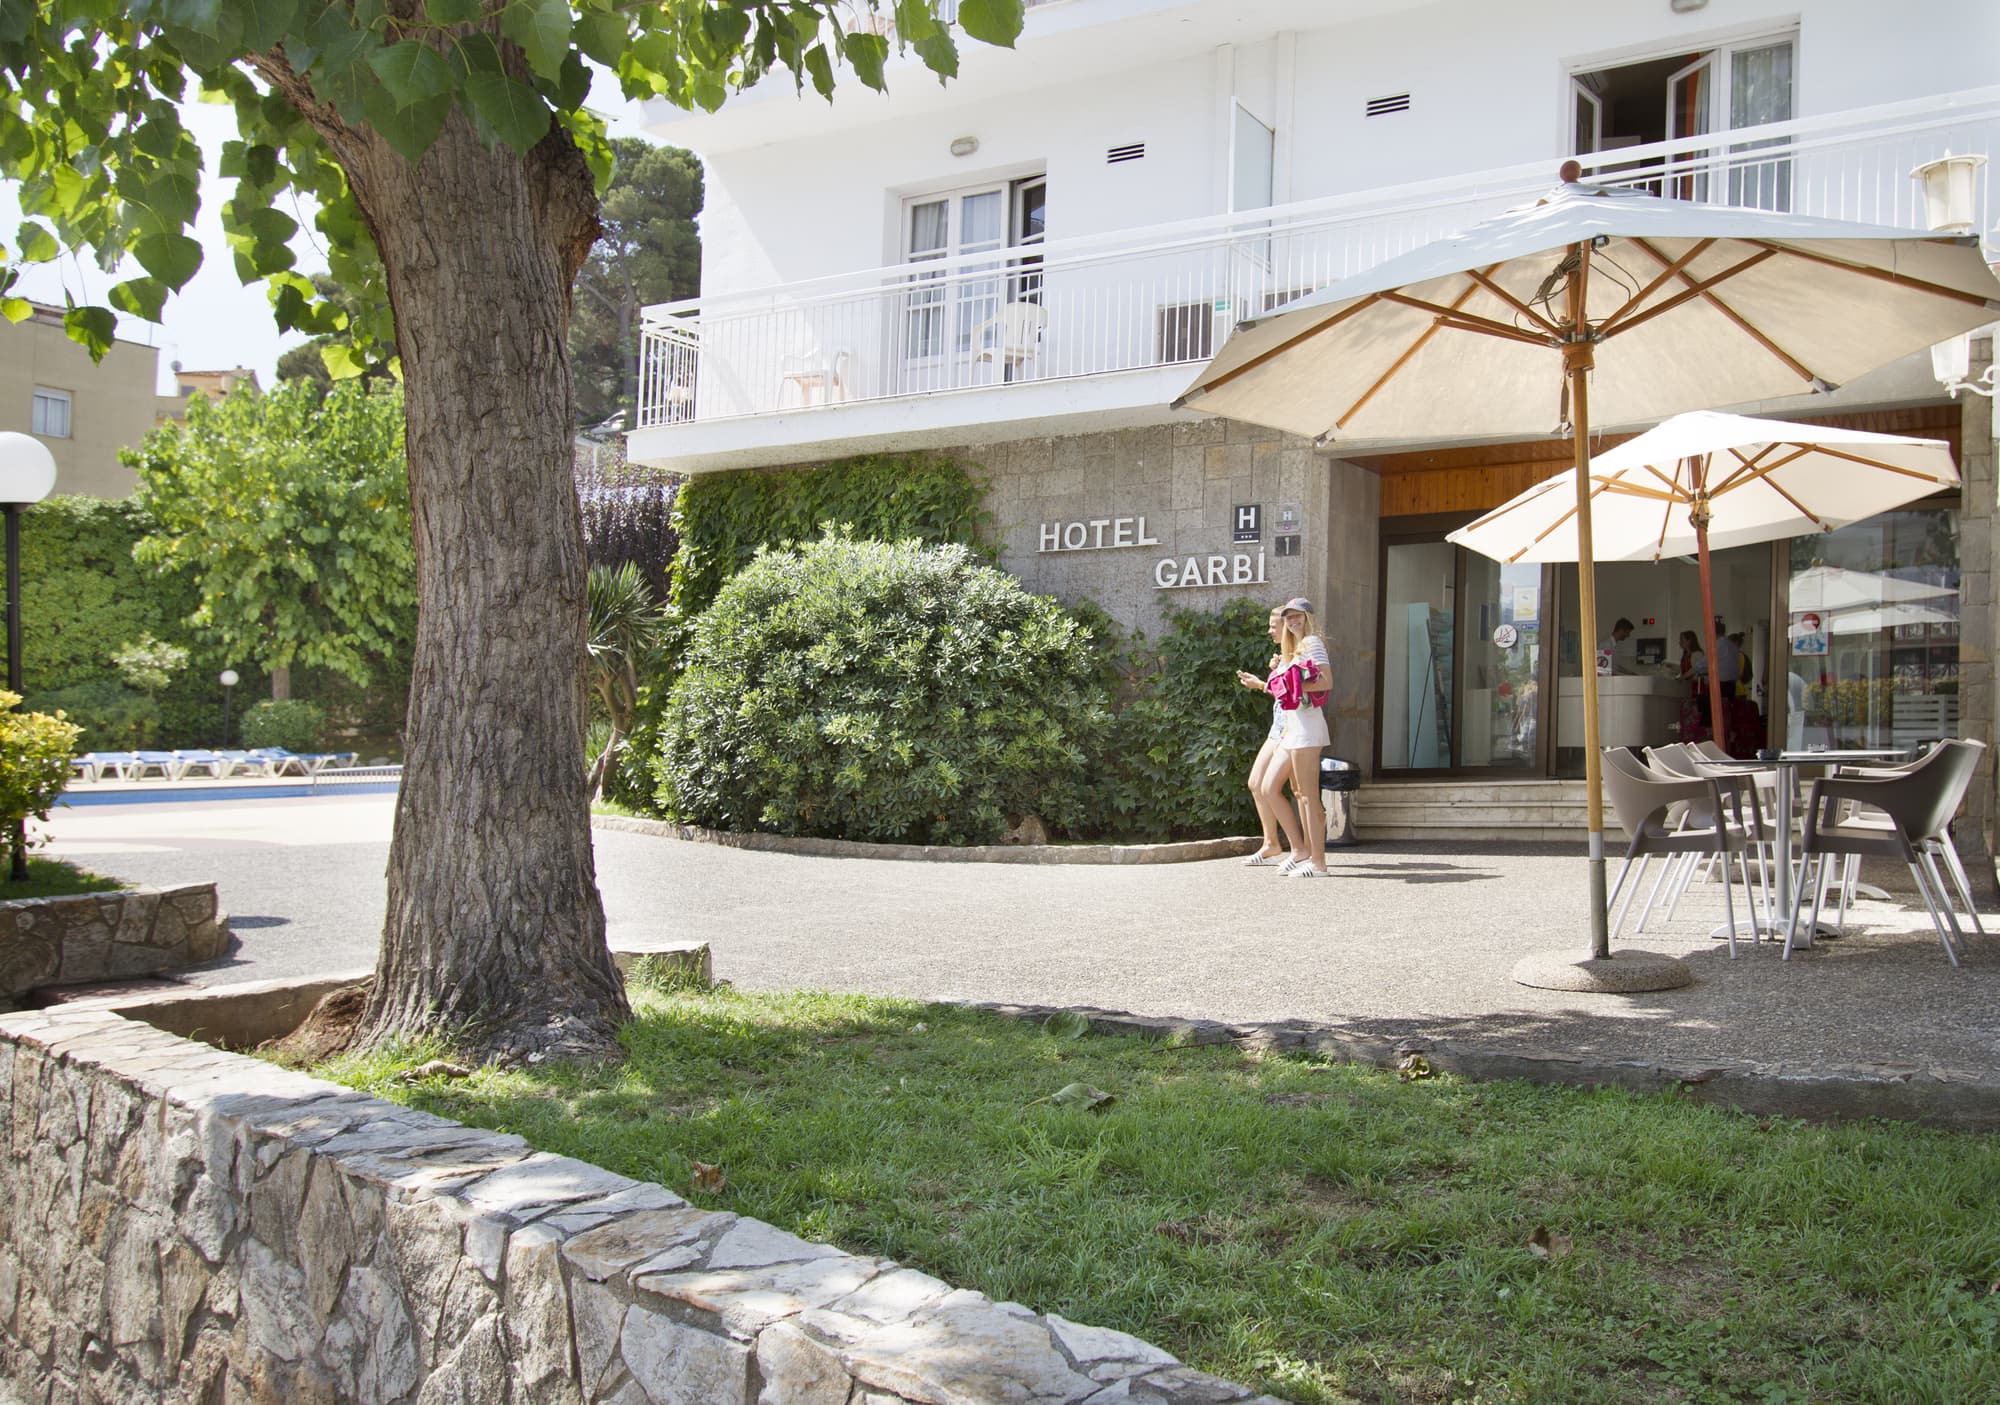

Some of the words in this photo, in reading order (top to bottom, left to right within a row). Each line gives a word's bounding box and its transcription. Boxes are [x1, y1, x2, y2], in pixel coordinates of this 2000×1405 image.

[1040, 517, 1157, 551] HOTEL
[1239, 507, 1255, 529] H
[1155, 546, 1265, 587] GARBÍ
